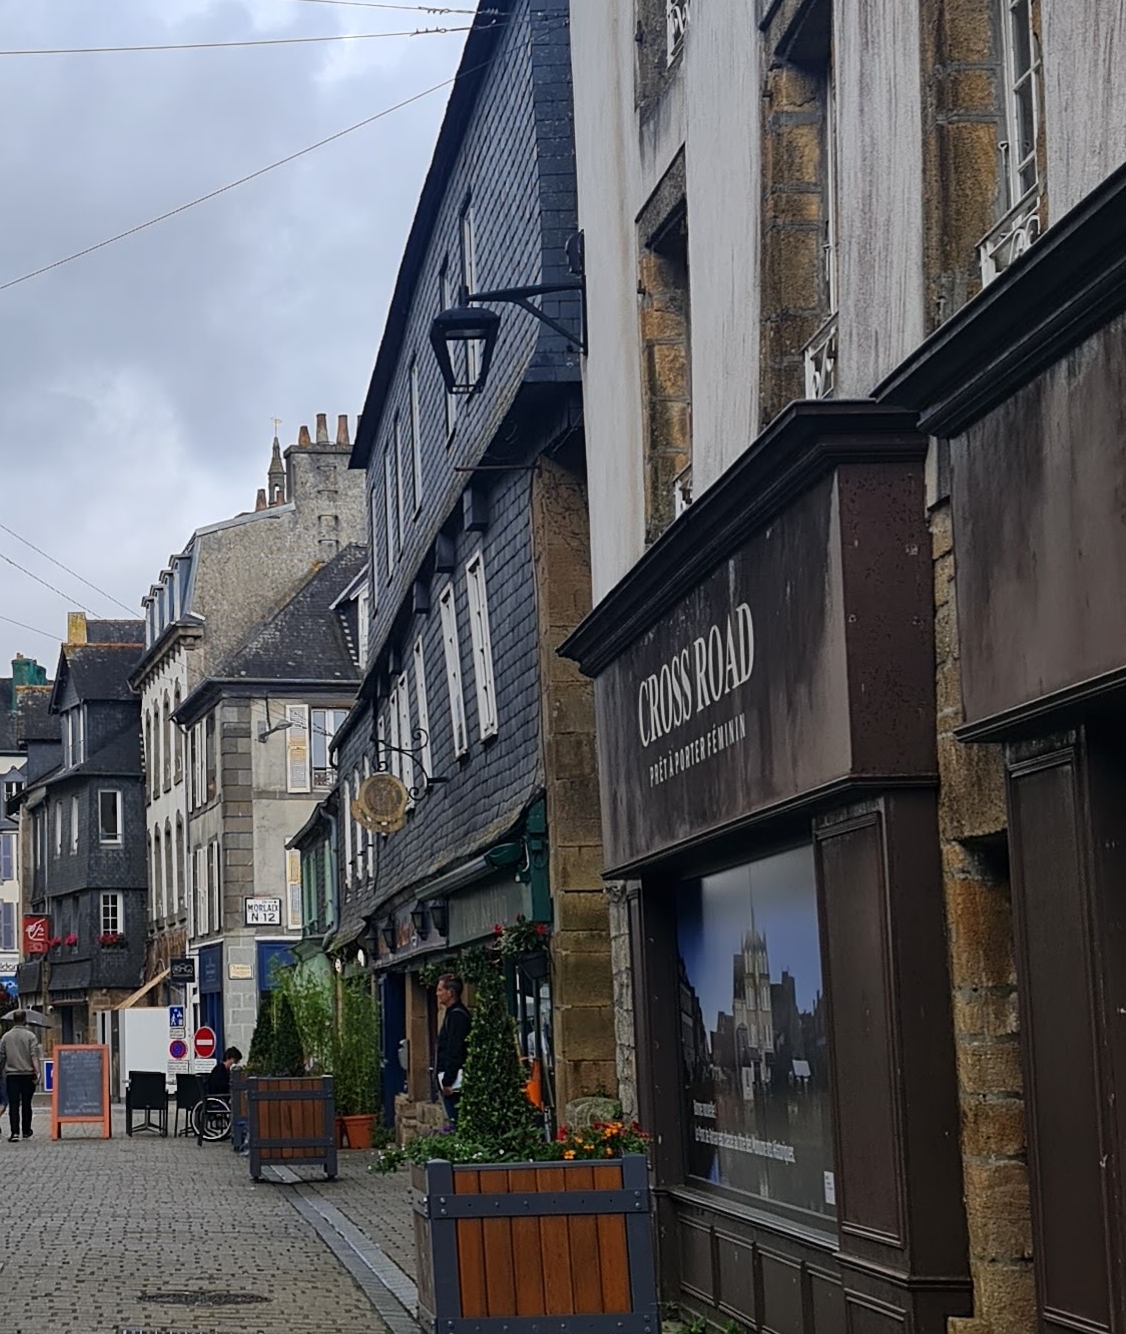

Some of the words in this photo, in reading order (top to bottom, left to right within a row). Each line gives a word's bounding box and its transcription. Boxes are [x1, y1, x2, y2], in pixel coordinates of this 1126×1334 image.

[638, 647, 692, 748] CROSS
[694, 602, 755, 713] ROAD
[649, 755, 668, 788] PRÊT
[668, 749, 675, 778] À
[675, 735, 706, 775] PORTER
[707, 712, 746, 757] FÉMININ
[251, 912, 259, 922] N
[263, 912, 276, 922] 12
